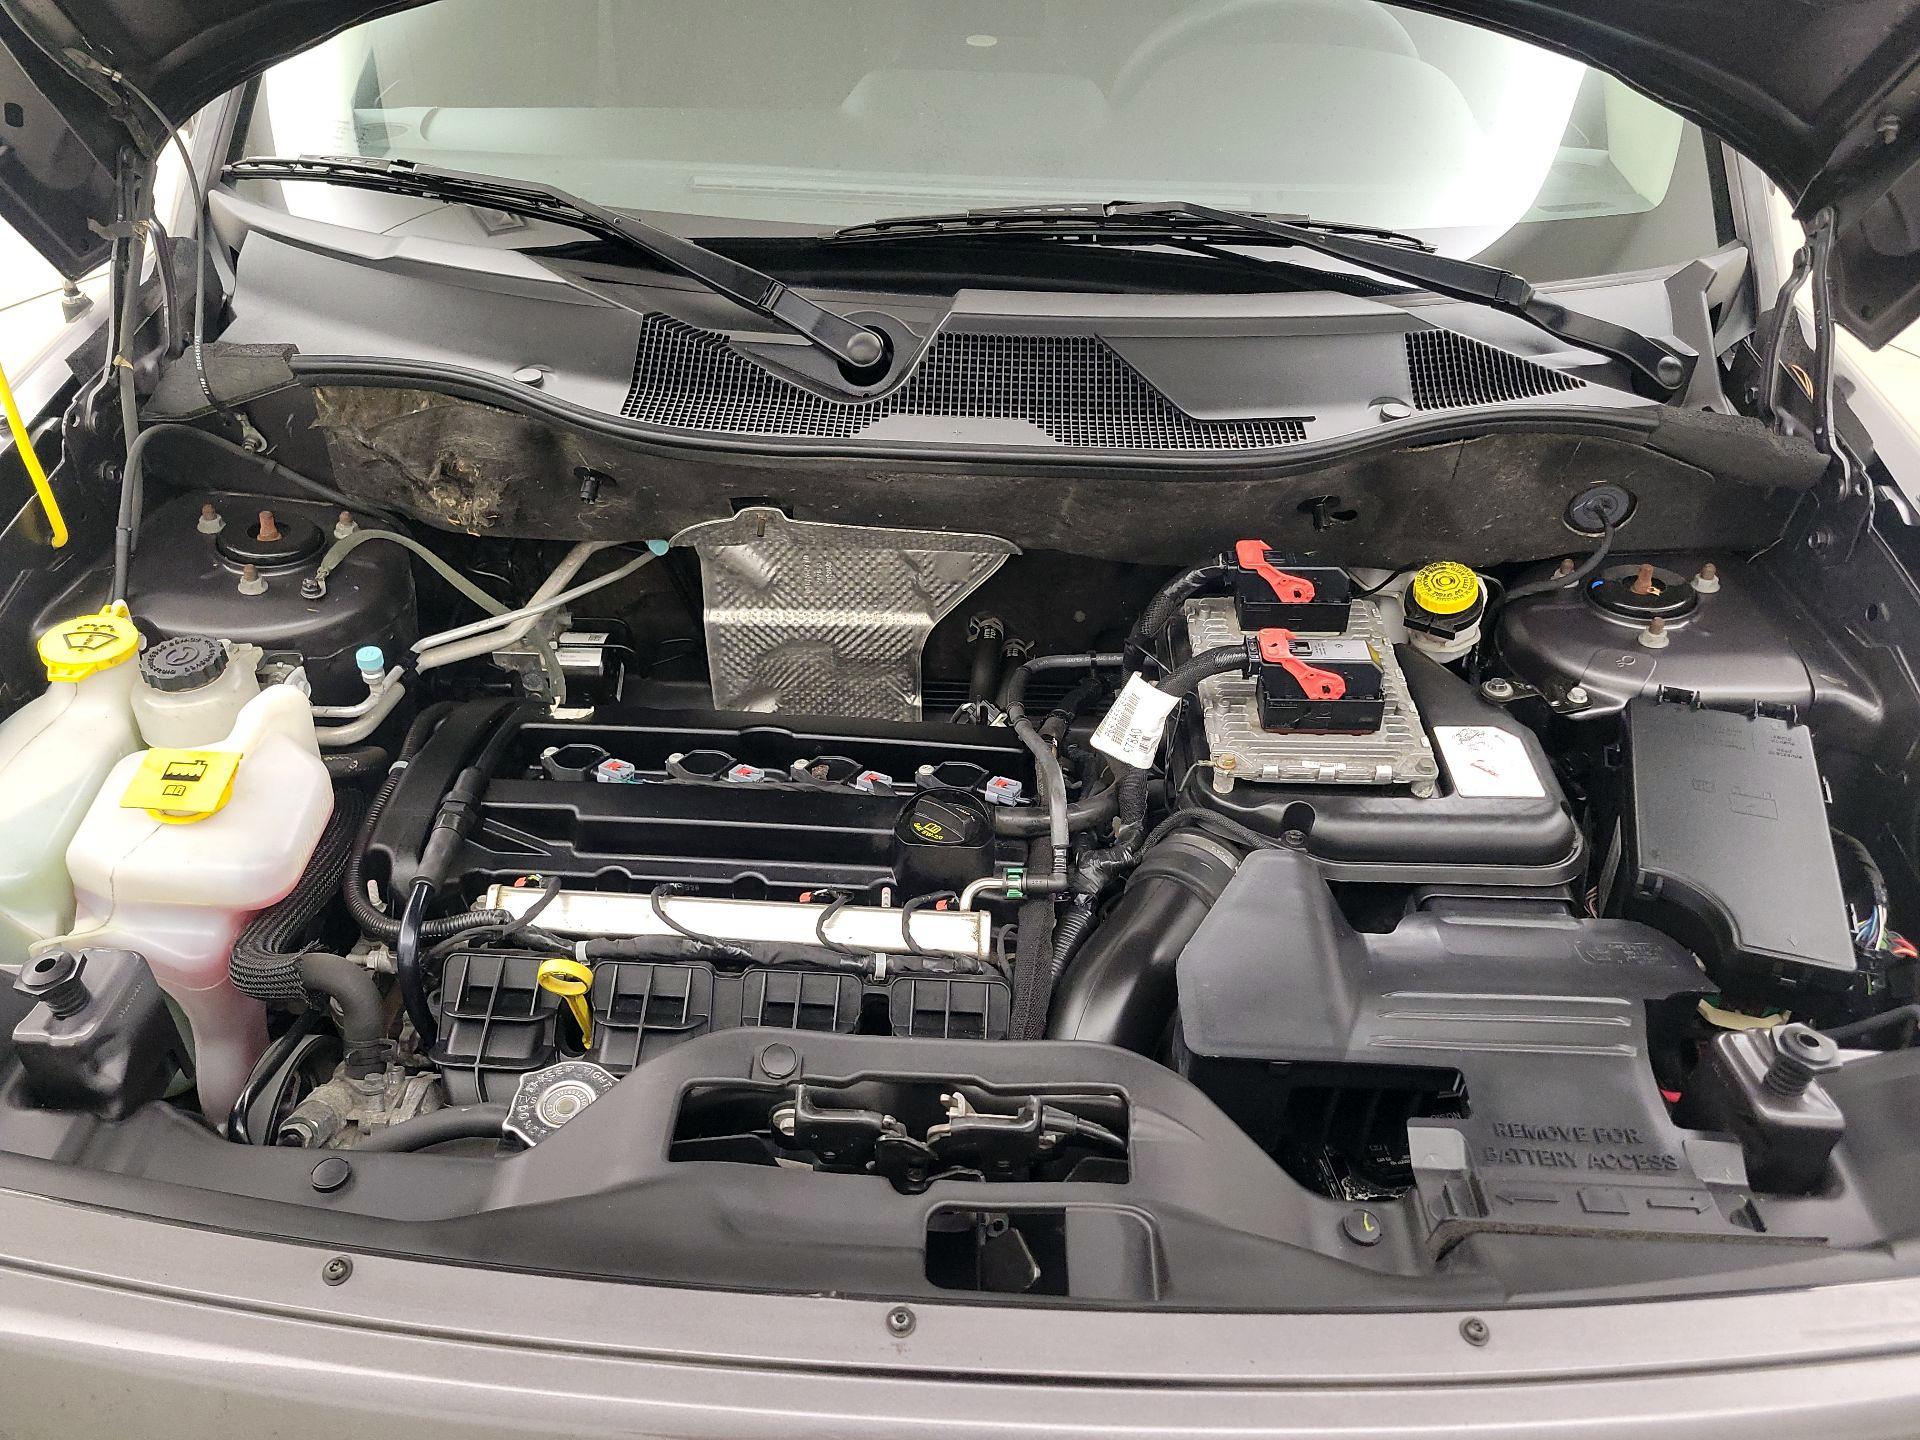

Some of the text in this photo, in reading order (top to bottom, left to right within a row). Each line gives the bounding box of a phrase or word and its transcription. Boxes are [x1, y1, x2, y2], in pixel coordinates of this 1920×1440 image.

[536, 1065, 576, 1083] KEEP
[1493, 1122, 1643, 1144] REMOVE FOR
[1484, 1146, 1681, 1171] BATTERY ACCESS
